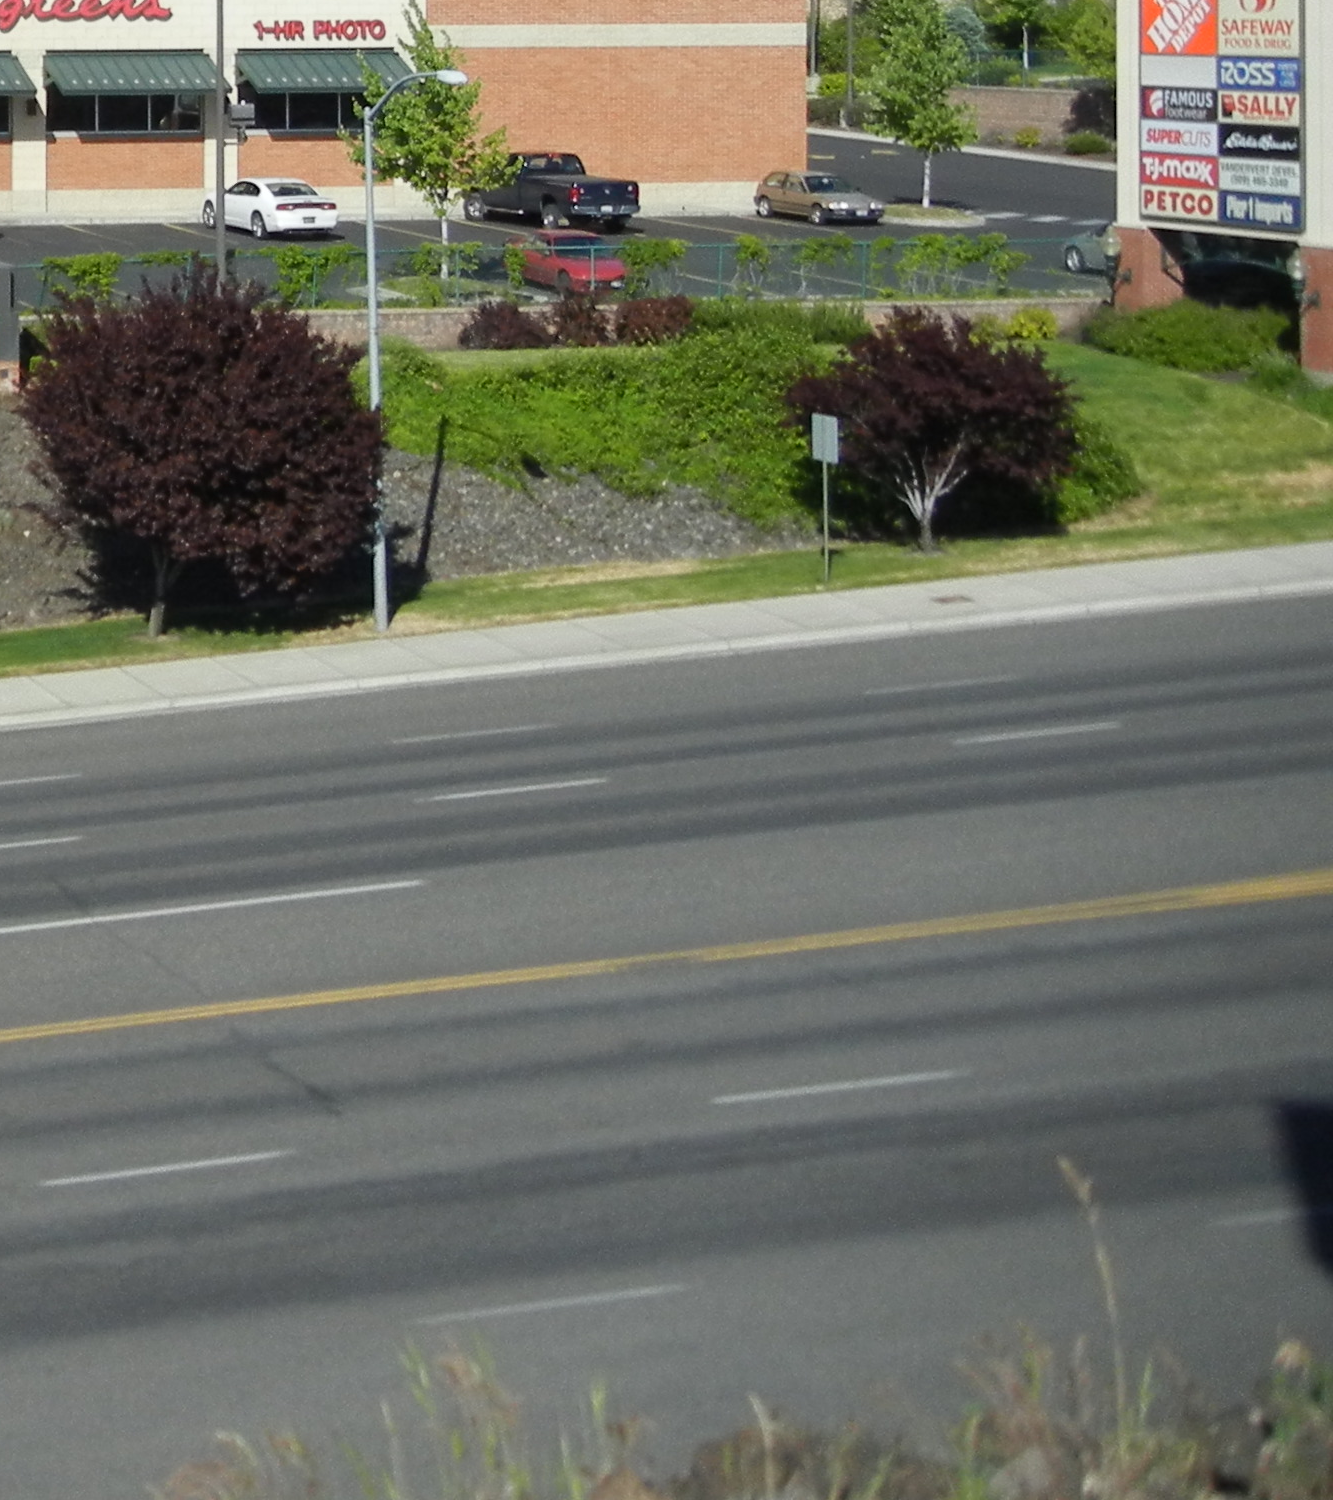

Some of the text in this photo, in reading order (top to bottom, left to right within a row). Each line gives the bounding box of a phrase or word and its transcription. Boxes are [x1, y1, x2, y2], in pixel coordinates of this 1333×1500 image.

[253, 19, 386, 41] 1-HR PHOTO
[1221, 19, 1294, 36] SAFEWAY
[1224, 38, 1292, 50] FOOD & DRUG
[1221, 61, 1275, 86] ROSS
[1164, 90, 1213, 108] FAMOUS
[1237, 94, 1296, 116] SALLY
[1165, 107, 1207, 118] footwear
[1146, 128, 1211, 148] SUPERCUTS
[1144, 189, 1213, 215] PETCO
